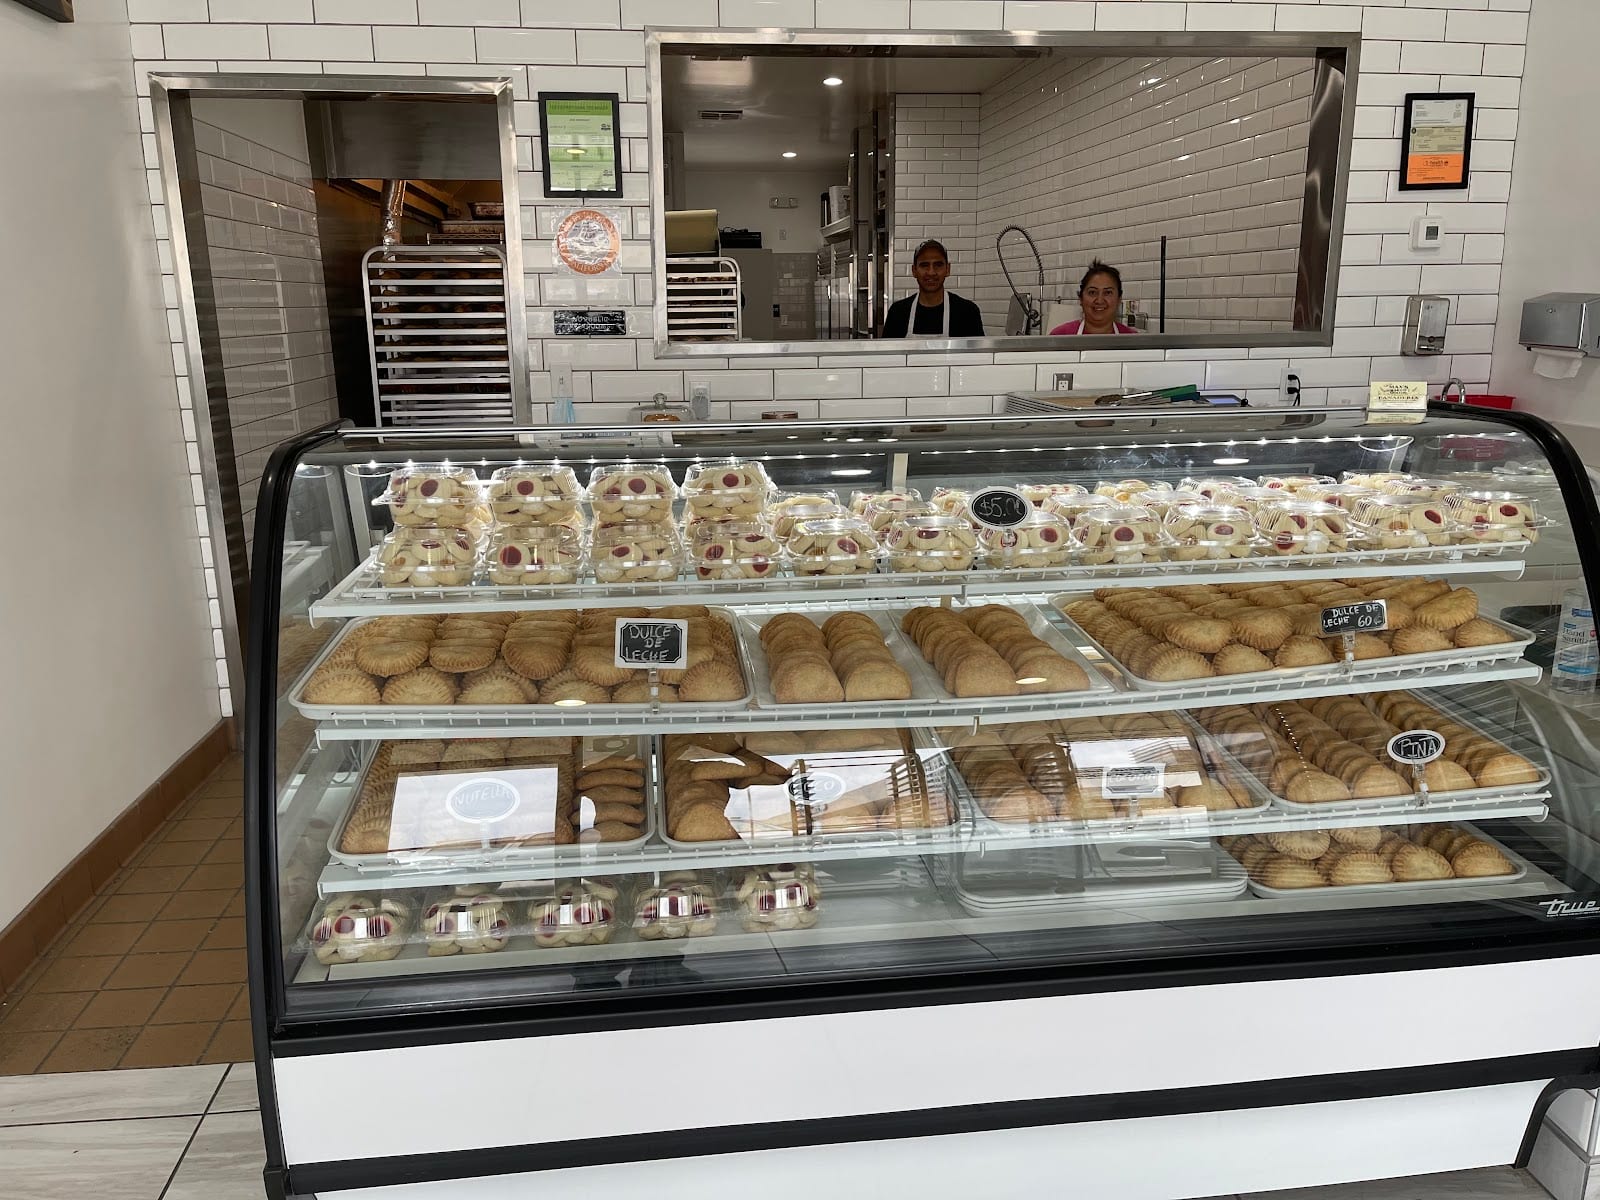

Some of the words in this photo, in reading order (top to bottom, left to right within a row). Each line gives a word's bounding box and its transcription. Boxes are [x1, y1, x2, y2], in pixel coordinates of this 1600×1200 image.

[1332, 606, 1360, 618] DULCE
[1323, 615, 1350, 628] LECHE
[629, 625, 672, 639] DULCE
[1562, 627, 1585, 638] Hand
[644, 637, 666, 648] DE
[625, 646, 670, 661] LECHE
